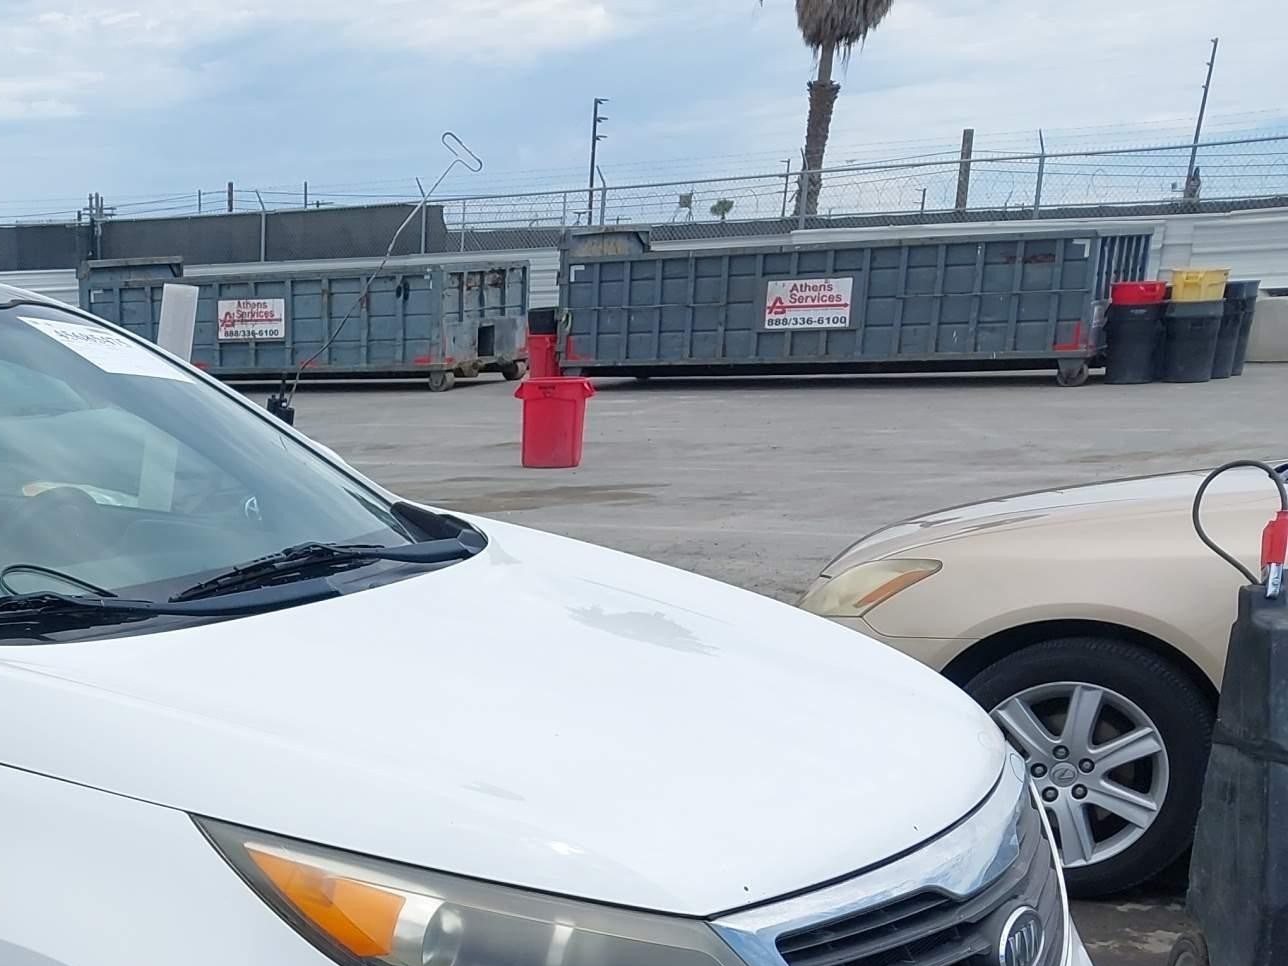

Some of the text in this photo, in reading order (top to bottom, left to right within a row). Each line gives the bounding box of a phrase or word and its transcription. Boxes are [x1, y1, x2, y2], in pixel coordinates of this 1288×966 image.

[789, 282, 834, 293] Athens
[789, 293, 842, 304] Services
[236, 301, 268, 309] Athens
[235, 309, 275, 319] Services
[767, 315, 847, 326] 888/336-6100
